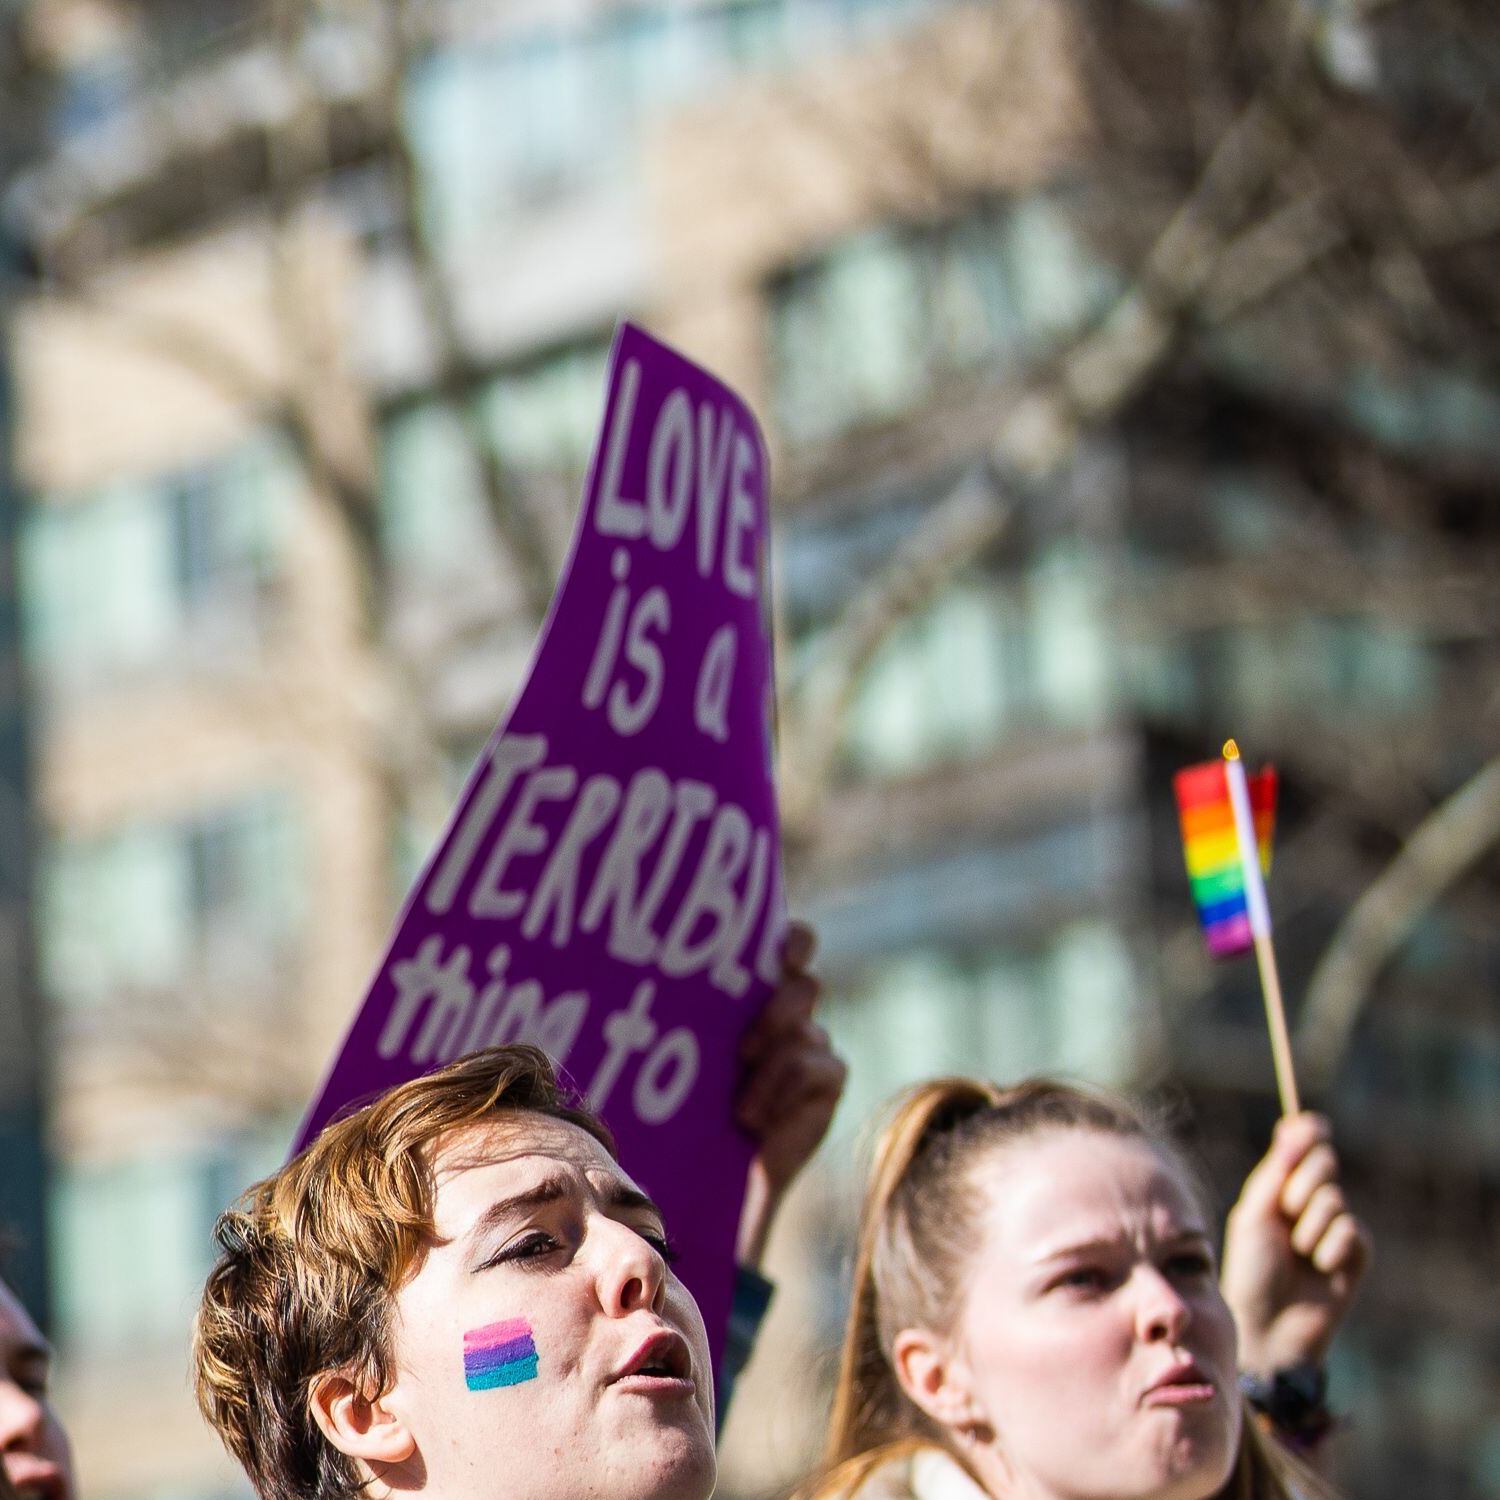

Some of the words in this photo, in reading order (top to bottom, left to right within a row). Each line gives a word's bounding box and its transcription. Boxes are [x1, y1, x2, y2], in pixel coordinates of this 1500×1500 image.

[595, 358, 761, 598] LOVE
[581, 547, 671, 737] is
[694, 622, 740, 744] a
[586, 980, 699, 1126] to
